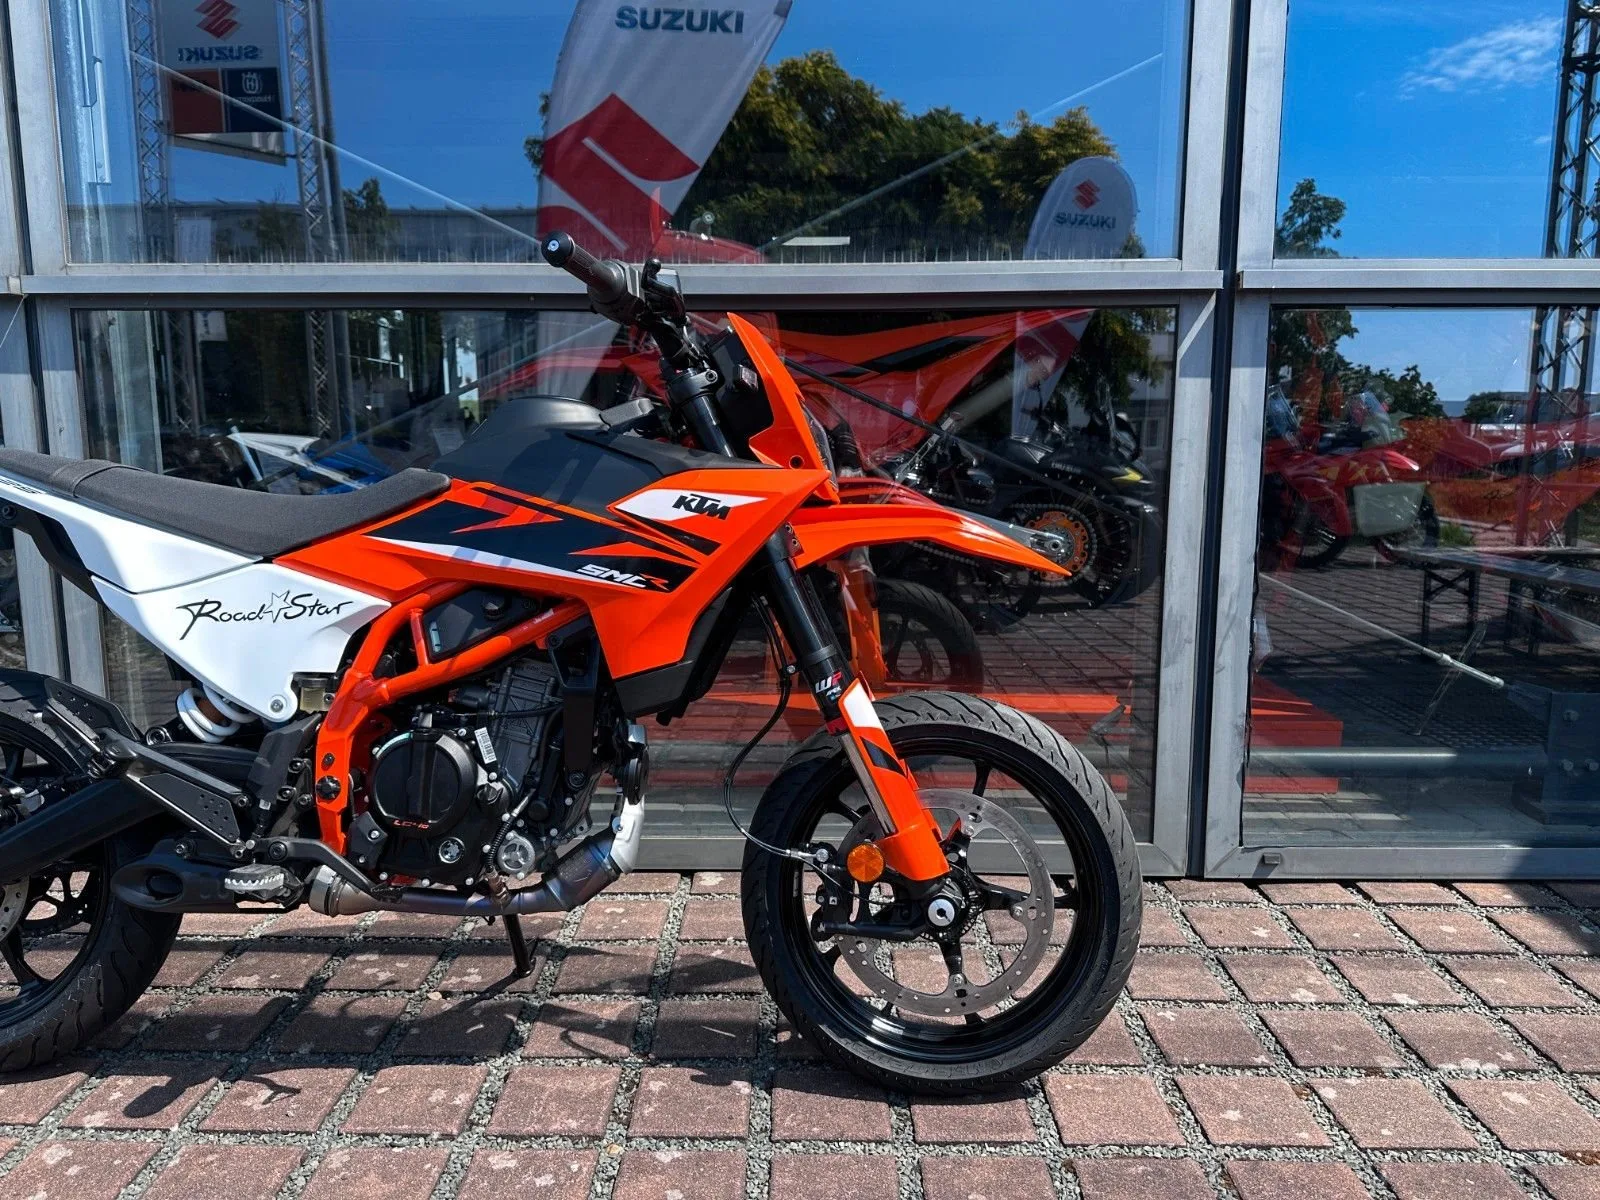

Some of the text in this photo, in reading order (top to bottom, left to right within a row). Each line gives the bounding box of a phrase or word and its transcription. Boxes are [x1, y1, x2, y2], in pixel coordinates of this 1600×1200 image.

[615, 5, 744, 34] SUZUKI
[1055, 211, 1117, 229] SUZUKI
[672, 493, 731, 520] KTM
[175, 593, 354, 641] Road Star
